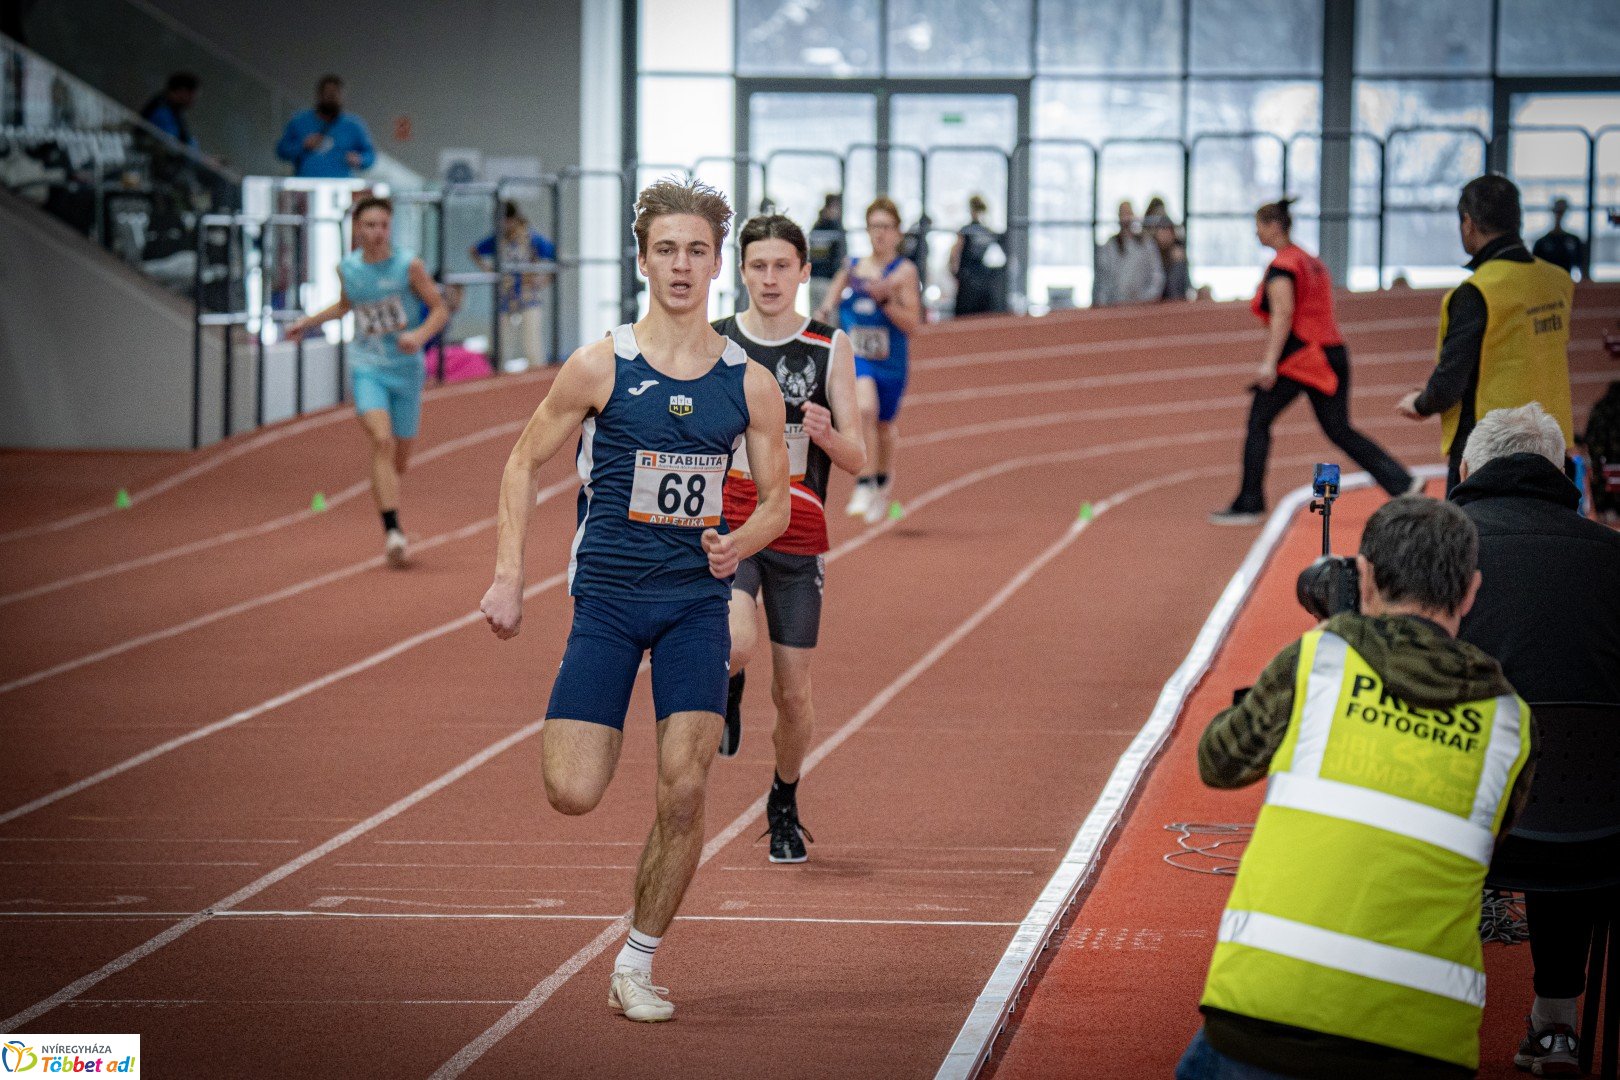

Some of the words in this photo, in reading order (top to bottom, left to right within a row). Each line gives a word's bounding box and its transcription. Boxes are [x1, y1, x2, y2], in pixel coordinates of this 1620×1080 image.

[659, 454, 723, 466] STABILITA
[657, 472, 706, 517] 68
[649, 515, 705, 527] ATLETIKA
[1346, 702, 1480, 752] FOTOGRAF
